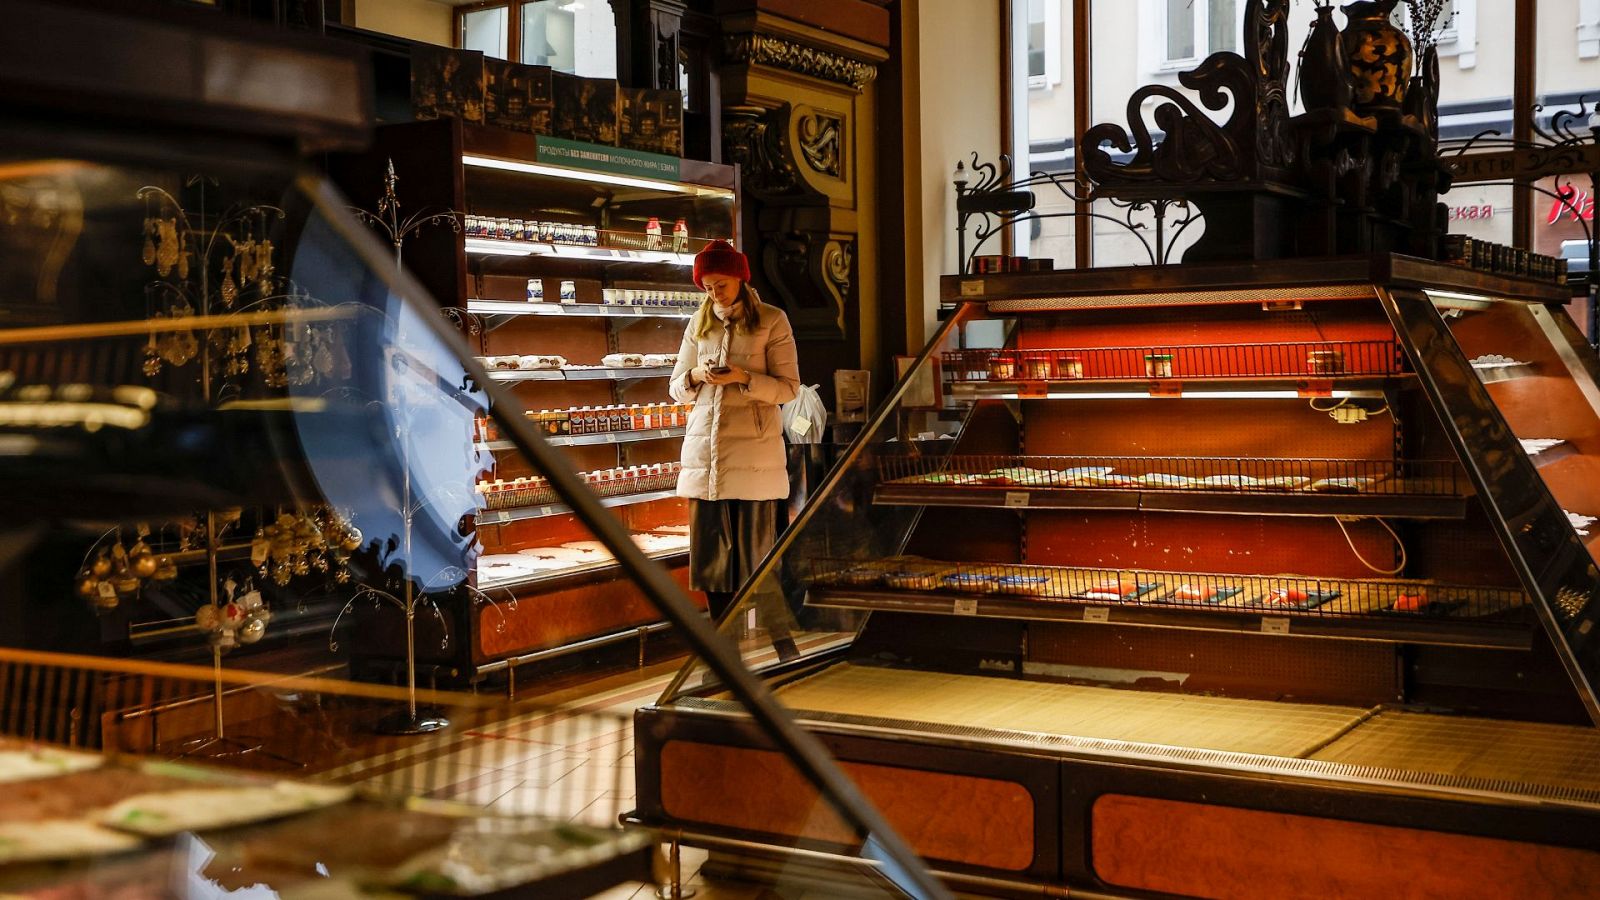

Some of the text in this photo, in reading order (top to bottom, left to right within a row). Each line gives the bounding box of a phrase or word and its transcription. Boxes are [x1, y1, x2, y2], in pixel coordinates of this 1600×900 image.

[539, 145, 570, 157] ПРОДУКТЫ
[570, 149, 580, 158] БЕЗ
[609, 155, 643, 168] МОЛОЧНОГО
[643, 159, 657, 169] ЖИРА
